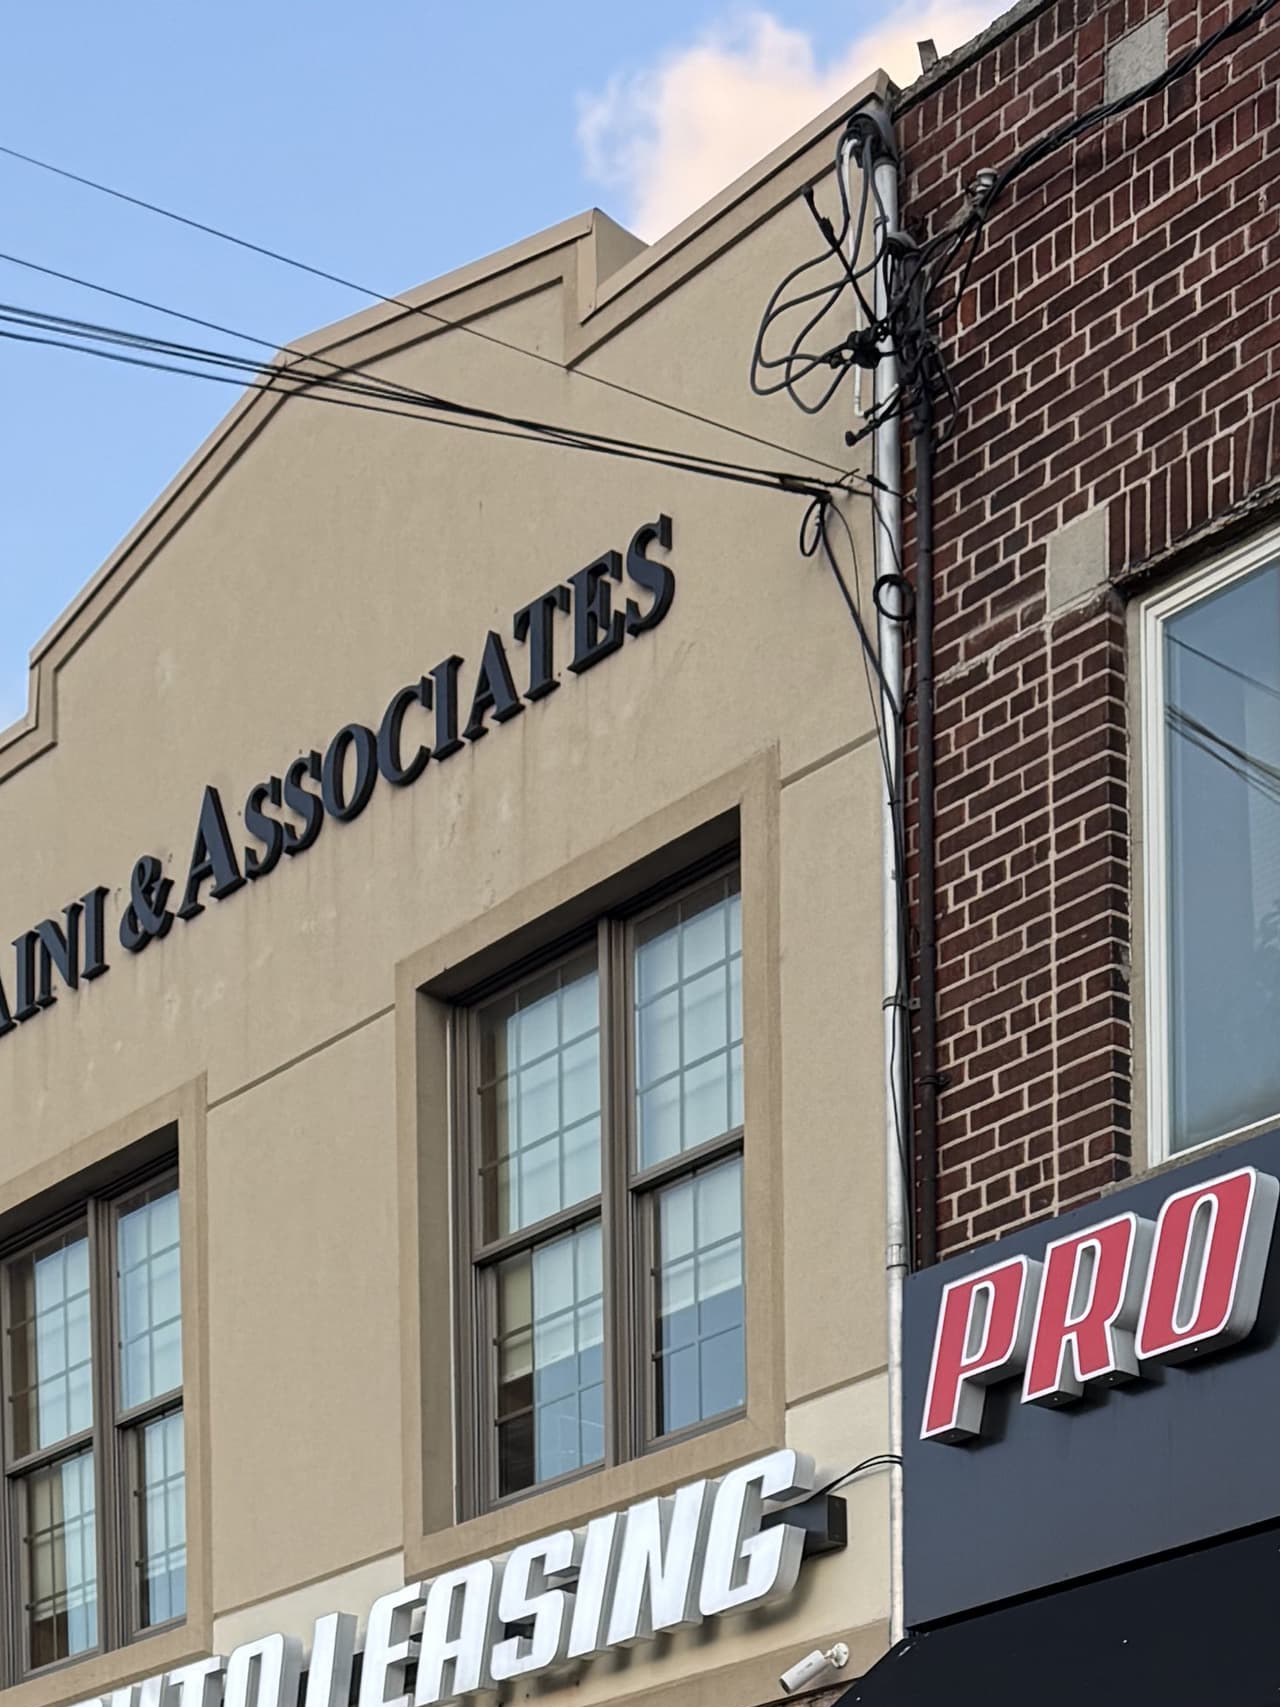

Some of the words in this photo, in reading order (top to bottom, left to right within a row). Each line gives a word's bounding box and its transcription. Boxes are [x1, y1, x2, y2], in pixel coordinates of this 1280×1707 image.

[117, 855, 174, 953] &
[176, 513, 677, 920] ASSOCIATES
[920, 1165, 1265, 1441] PRO
